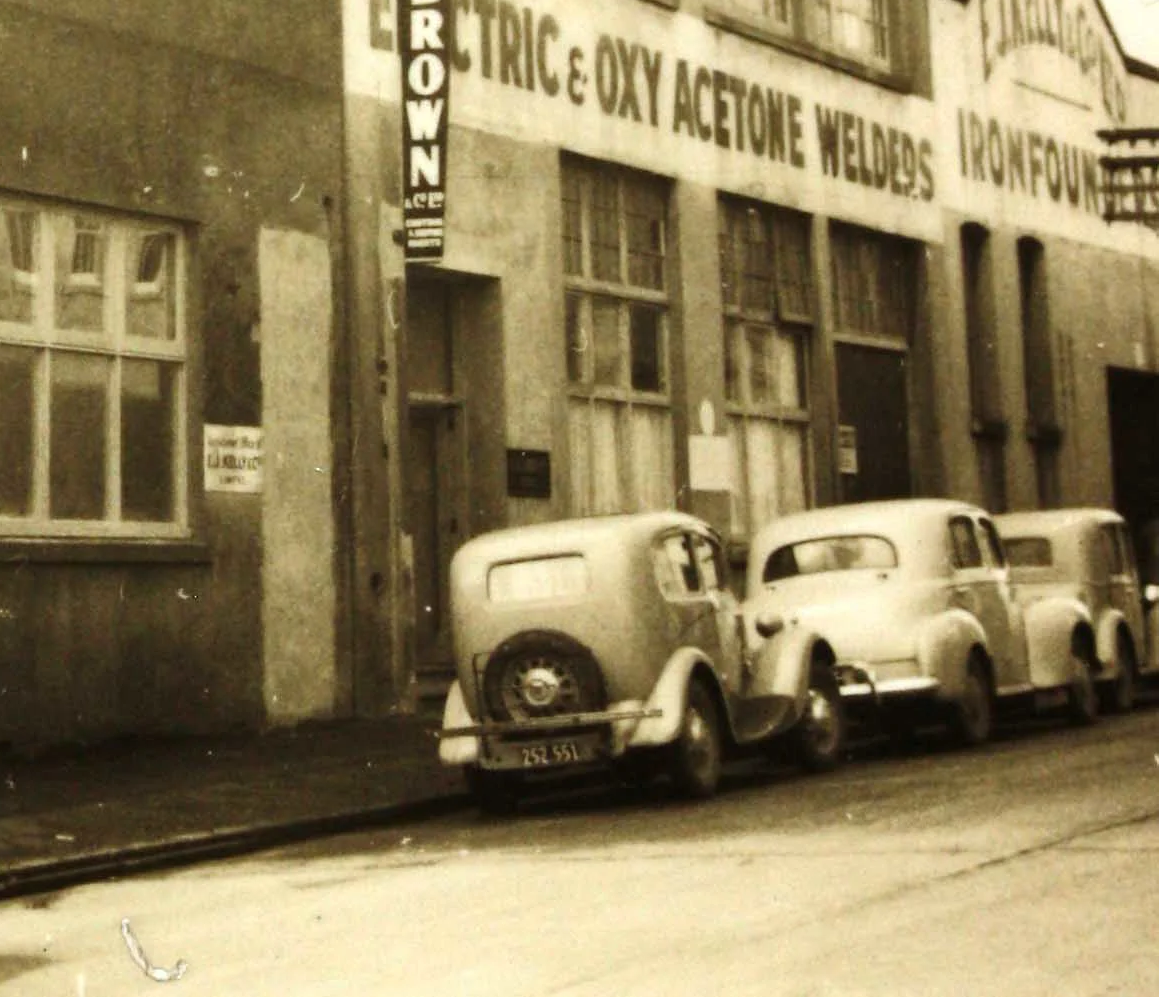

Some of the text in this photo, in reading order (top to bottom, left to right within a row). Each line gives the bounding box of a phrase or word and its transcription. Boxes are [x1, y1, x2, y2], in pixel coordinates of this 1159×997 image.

[566, 45, 588, 106] &
[594, 33, 662, 129] OXY
[672, 57, 806, 170] ACETONE
